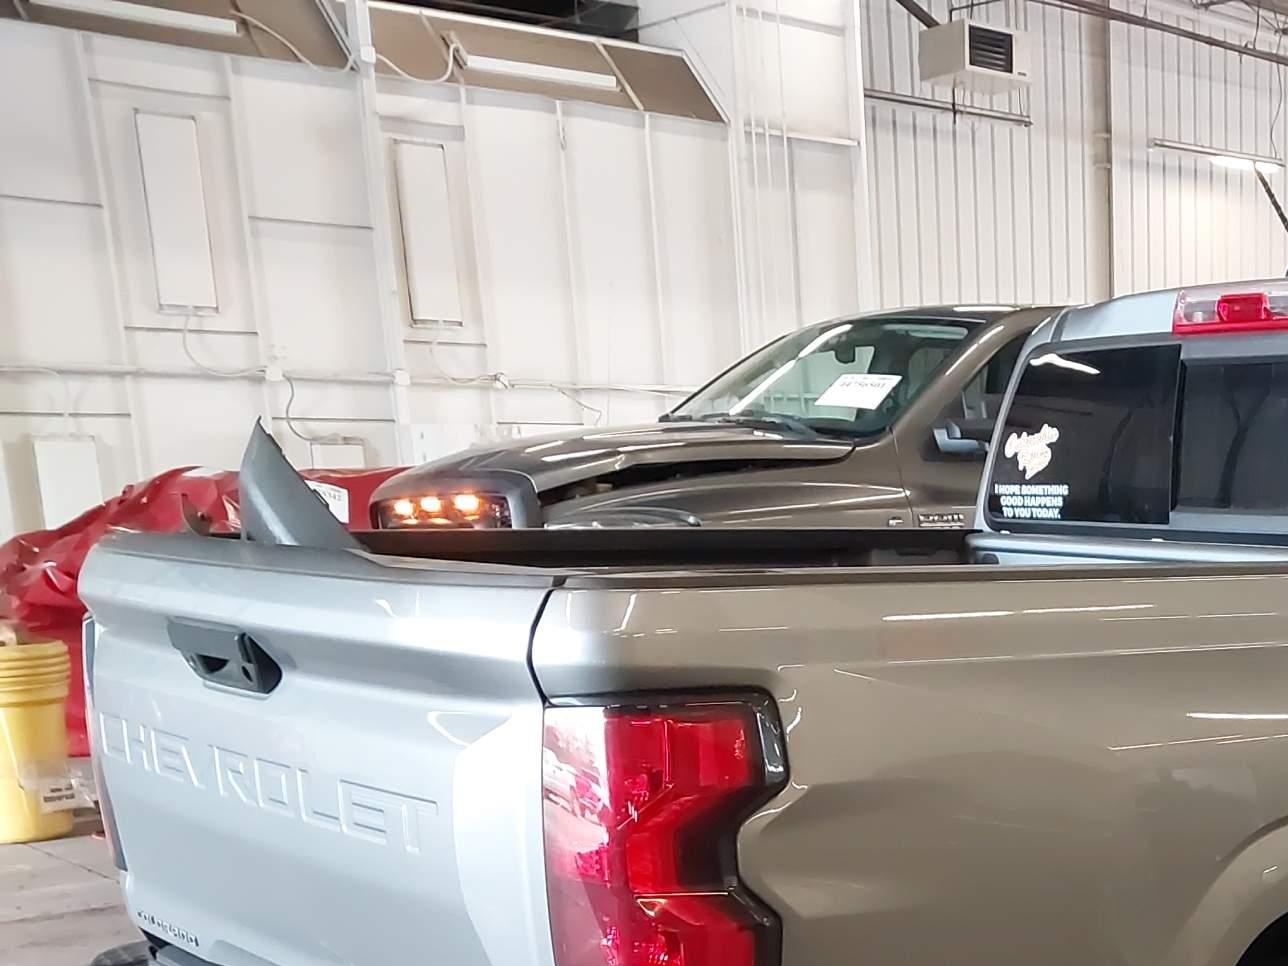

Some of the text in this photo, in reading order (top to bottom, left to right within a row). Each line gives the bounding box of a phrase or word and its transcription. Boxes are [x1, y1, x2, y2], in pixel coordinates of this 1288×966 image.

[999, 484, 1021, 496] HOPE
[1021, 484, 1069, 496] SOMETHING
[1000, 495, 1063, 508] GOOD HAPPENS
[1002, 506, 1061, 519] TO YOU TODAY.
[98, 711, 440, 856] CHEVROLET
